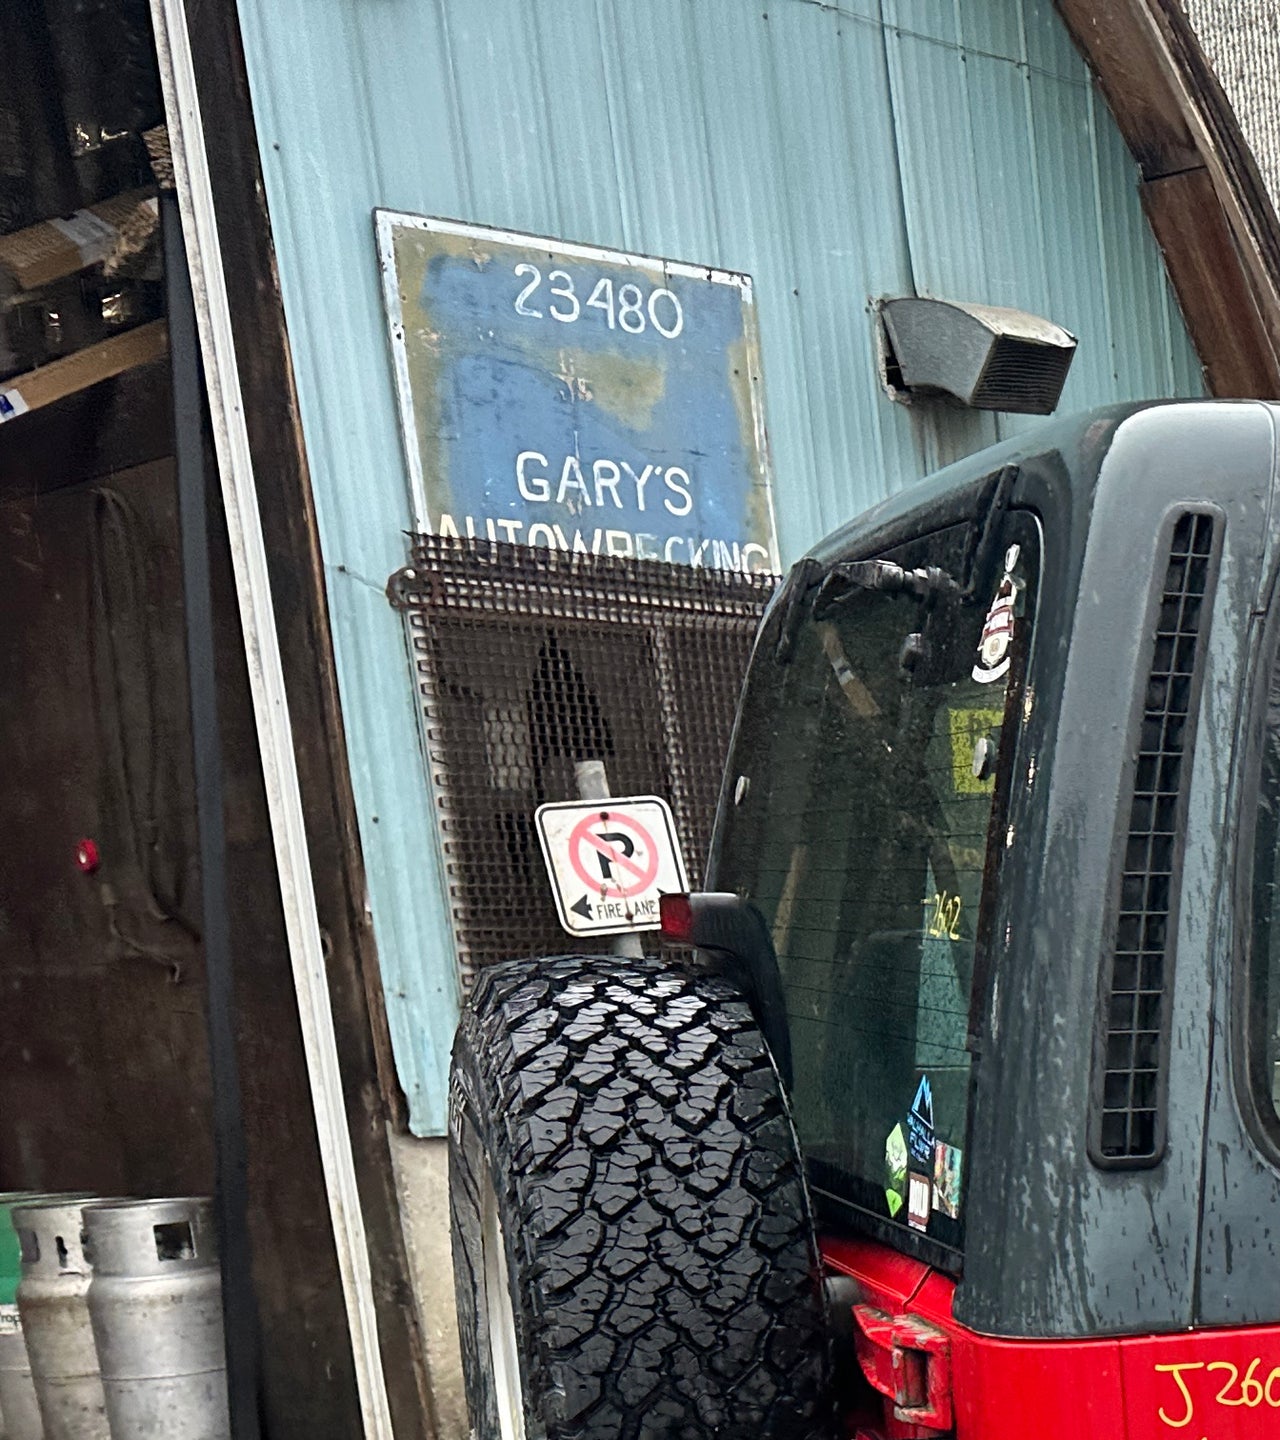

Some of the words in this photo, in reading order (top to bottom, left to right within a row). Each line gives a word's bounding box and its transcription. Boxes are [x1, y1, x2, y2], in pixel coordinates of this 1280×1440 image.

[514, 263, 684, 339] 23480
[515, 450, 694, 517] GARY'S
[597, 904, 624, 920] FIRE
[626, 899, 659, 917] ANE
